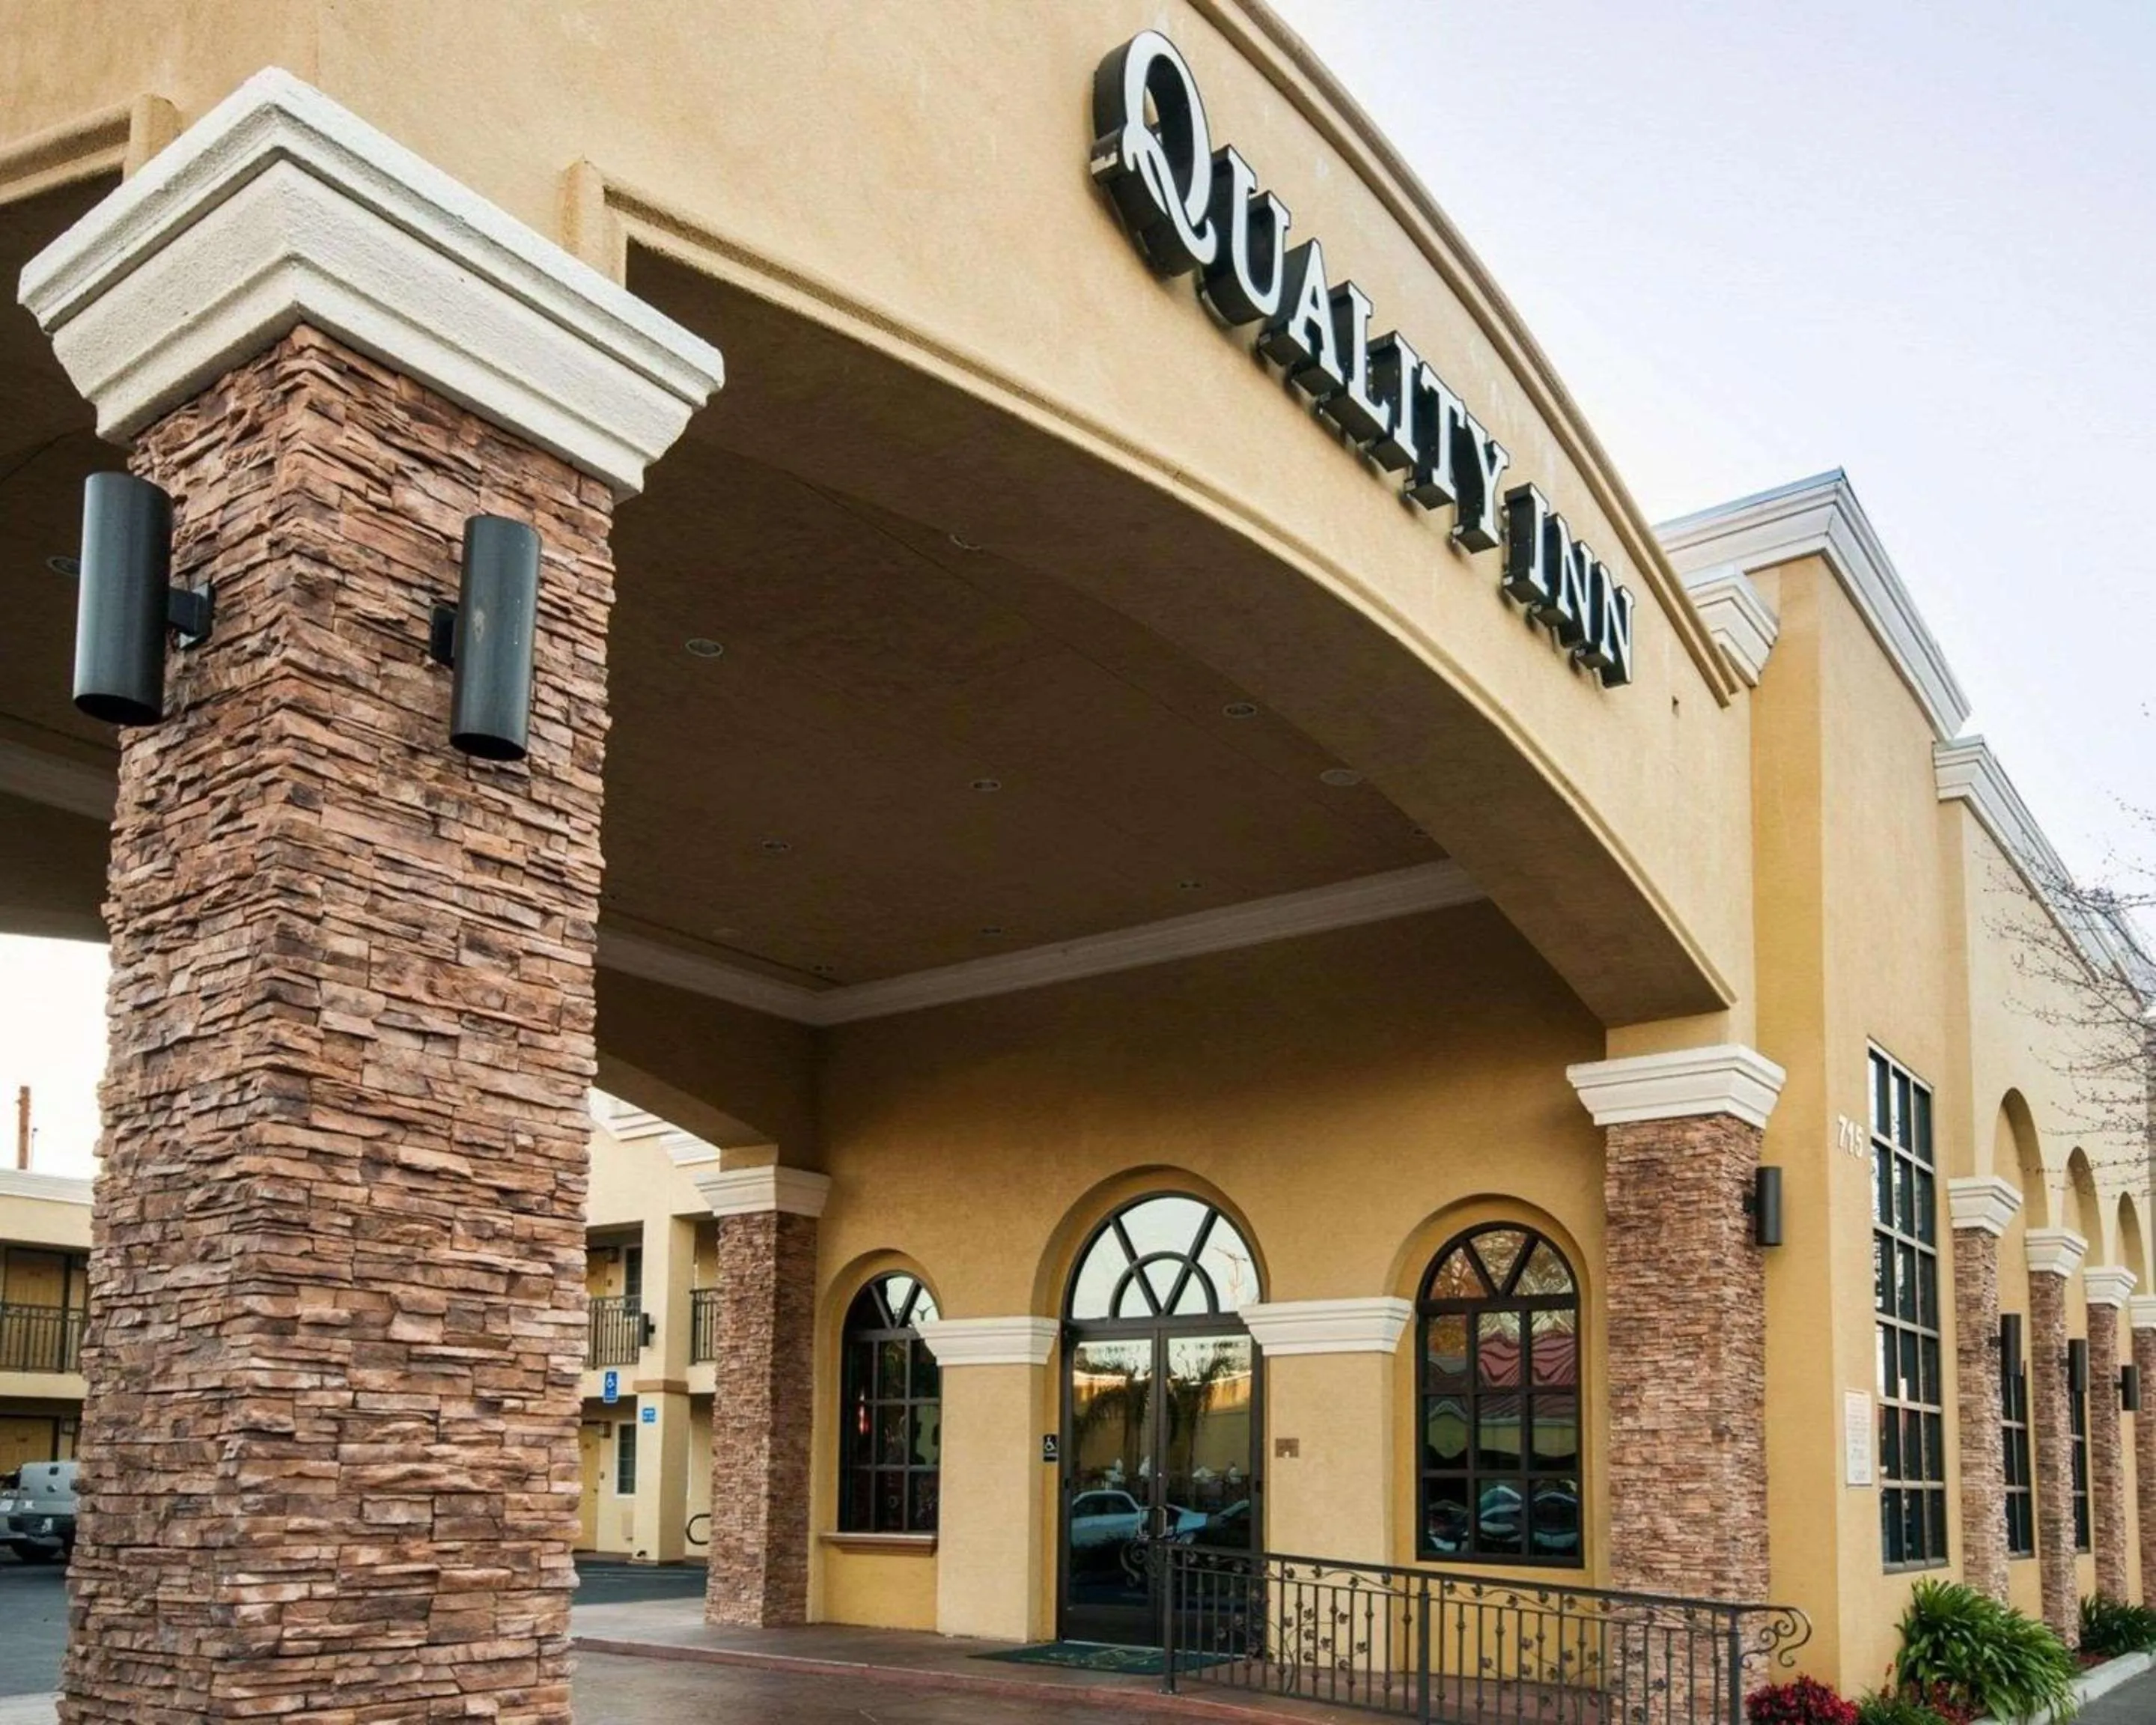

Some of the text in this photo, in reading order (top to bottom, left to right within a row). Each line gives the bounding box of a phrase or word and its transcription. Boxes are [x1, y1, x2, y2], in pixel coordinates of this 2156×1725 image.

[1118, 30, 1635, 685] QUALITY INN
[1839, 1113, 1863, 1157] 715
